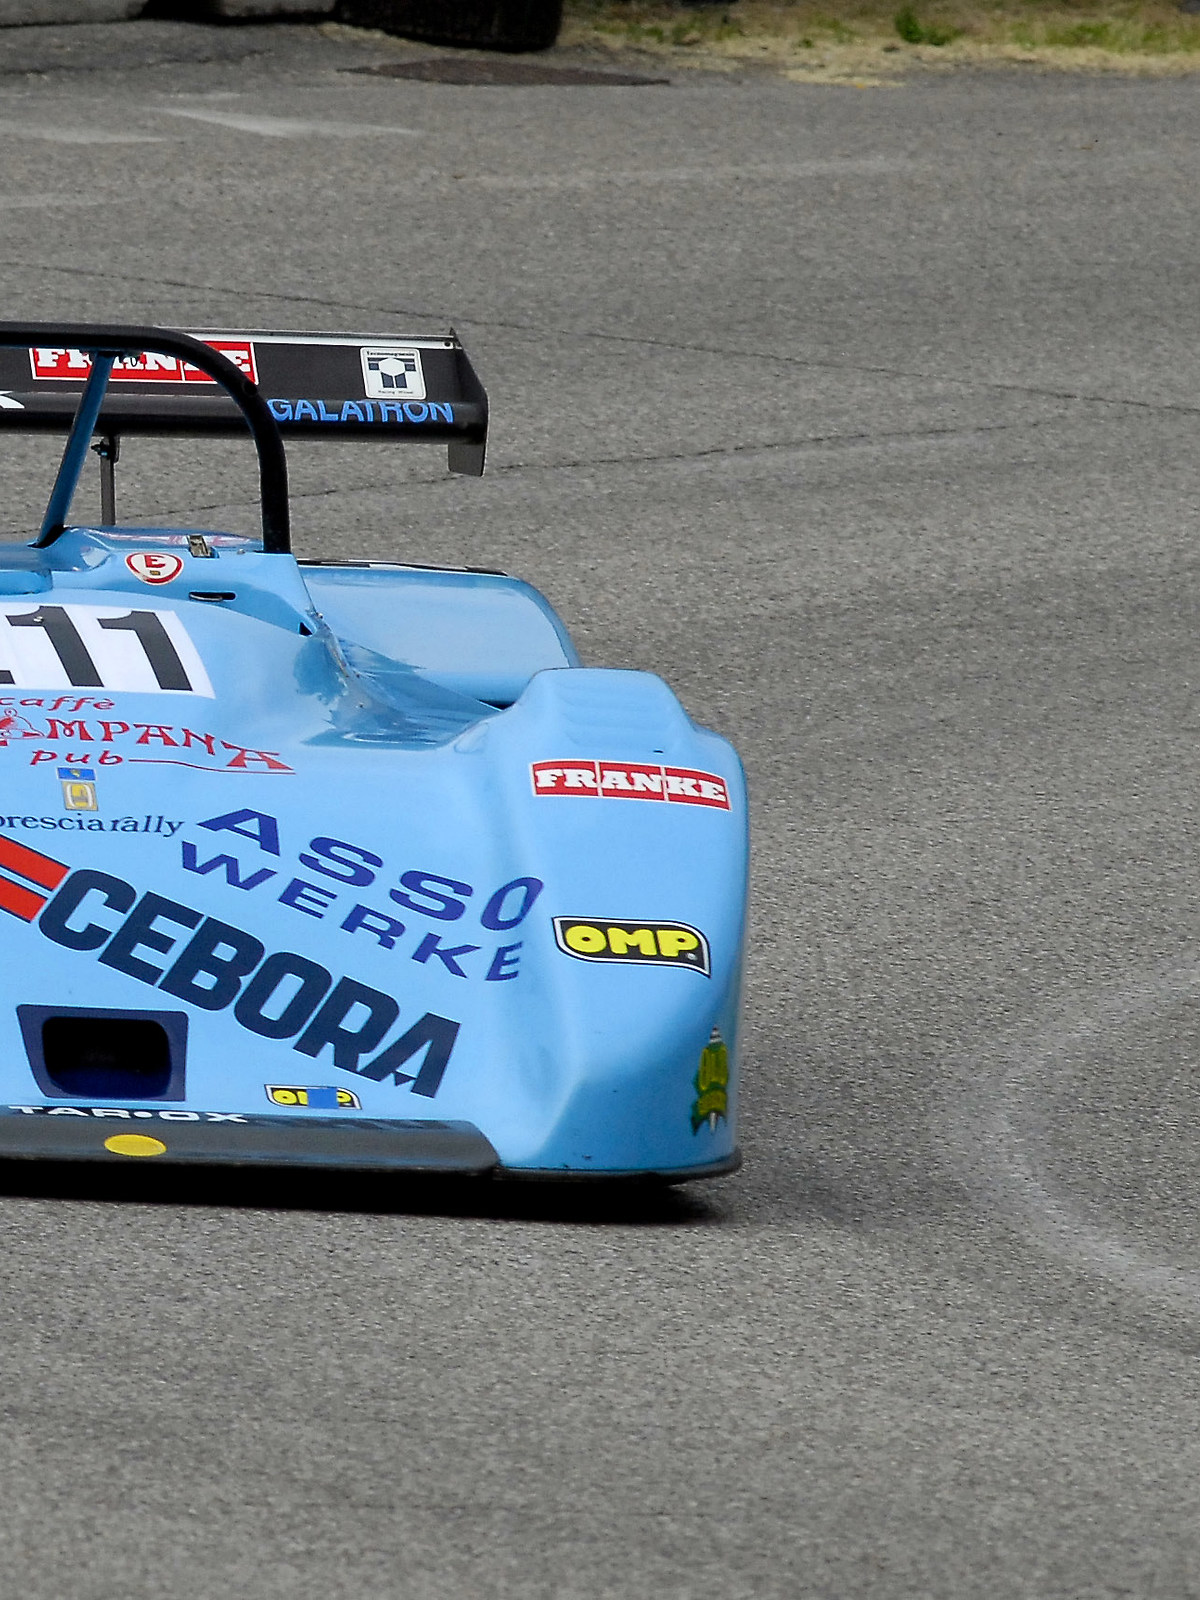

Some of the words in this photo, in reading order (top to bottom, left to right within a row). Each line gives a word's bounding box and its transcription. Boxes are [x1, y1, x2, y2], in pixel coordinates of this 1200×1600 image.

[268, 399, 454, 423] GALATRON
[30, 749, 123, 766] pub
[535, 769, 728, 802] FRANKE
[197, 808, 544, 931] ASSO
[181, 841, 523, 981] WERKE
[565, 924, 700, 959] OMP
[38, 869, 461, 1099] CEBORA
